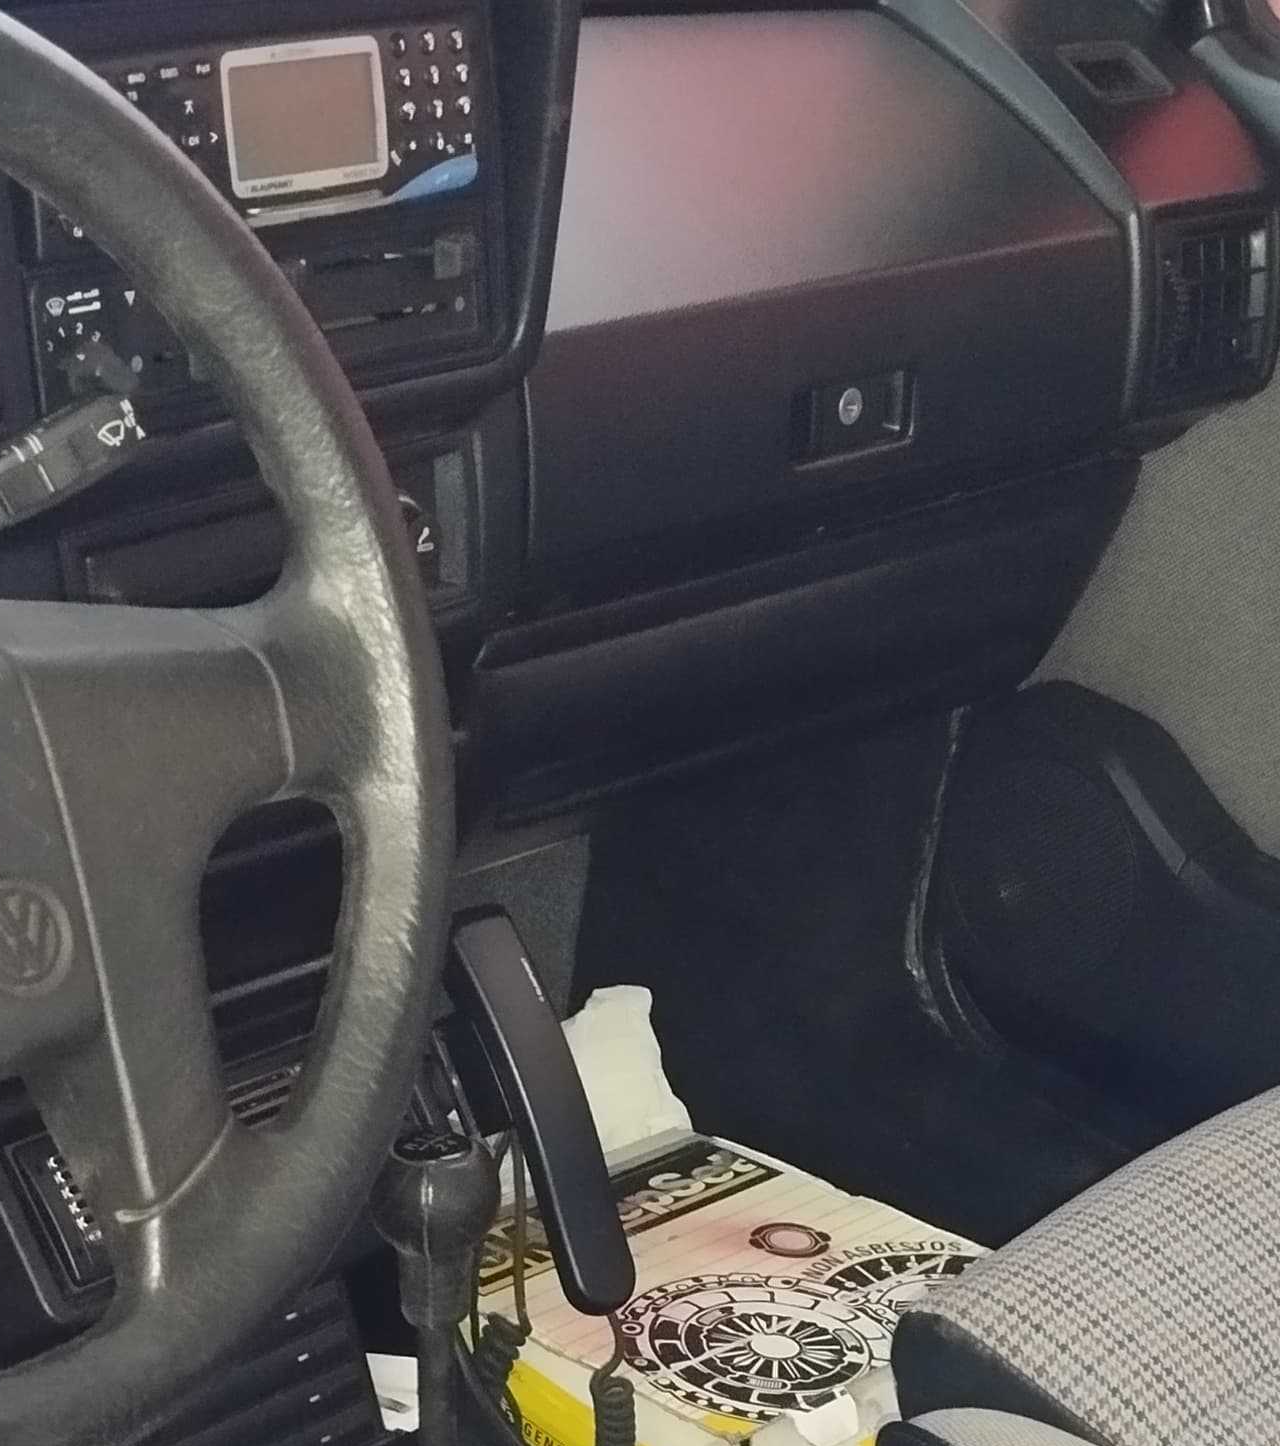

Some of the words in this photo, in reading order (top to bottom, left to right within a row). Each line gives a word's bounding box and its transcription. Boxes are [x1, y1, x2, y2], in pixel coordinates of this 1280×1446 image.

[75, 321, 84, 335] 2
[802, 1254, 844, 1280] NON
[845, 1240, 963, 1261] ASBESTOS
